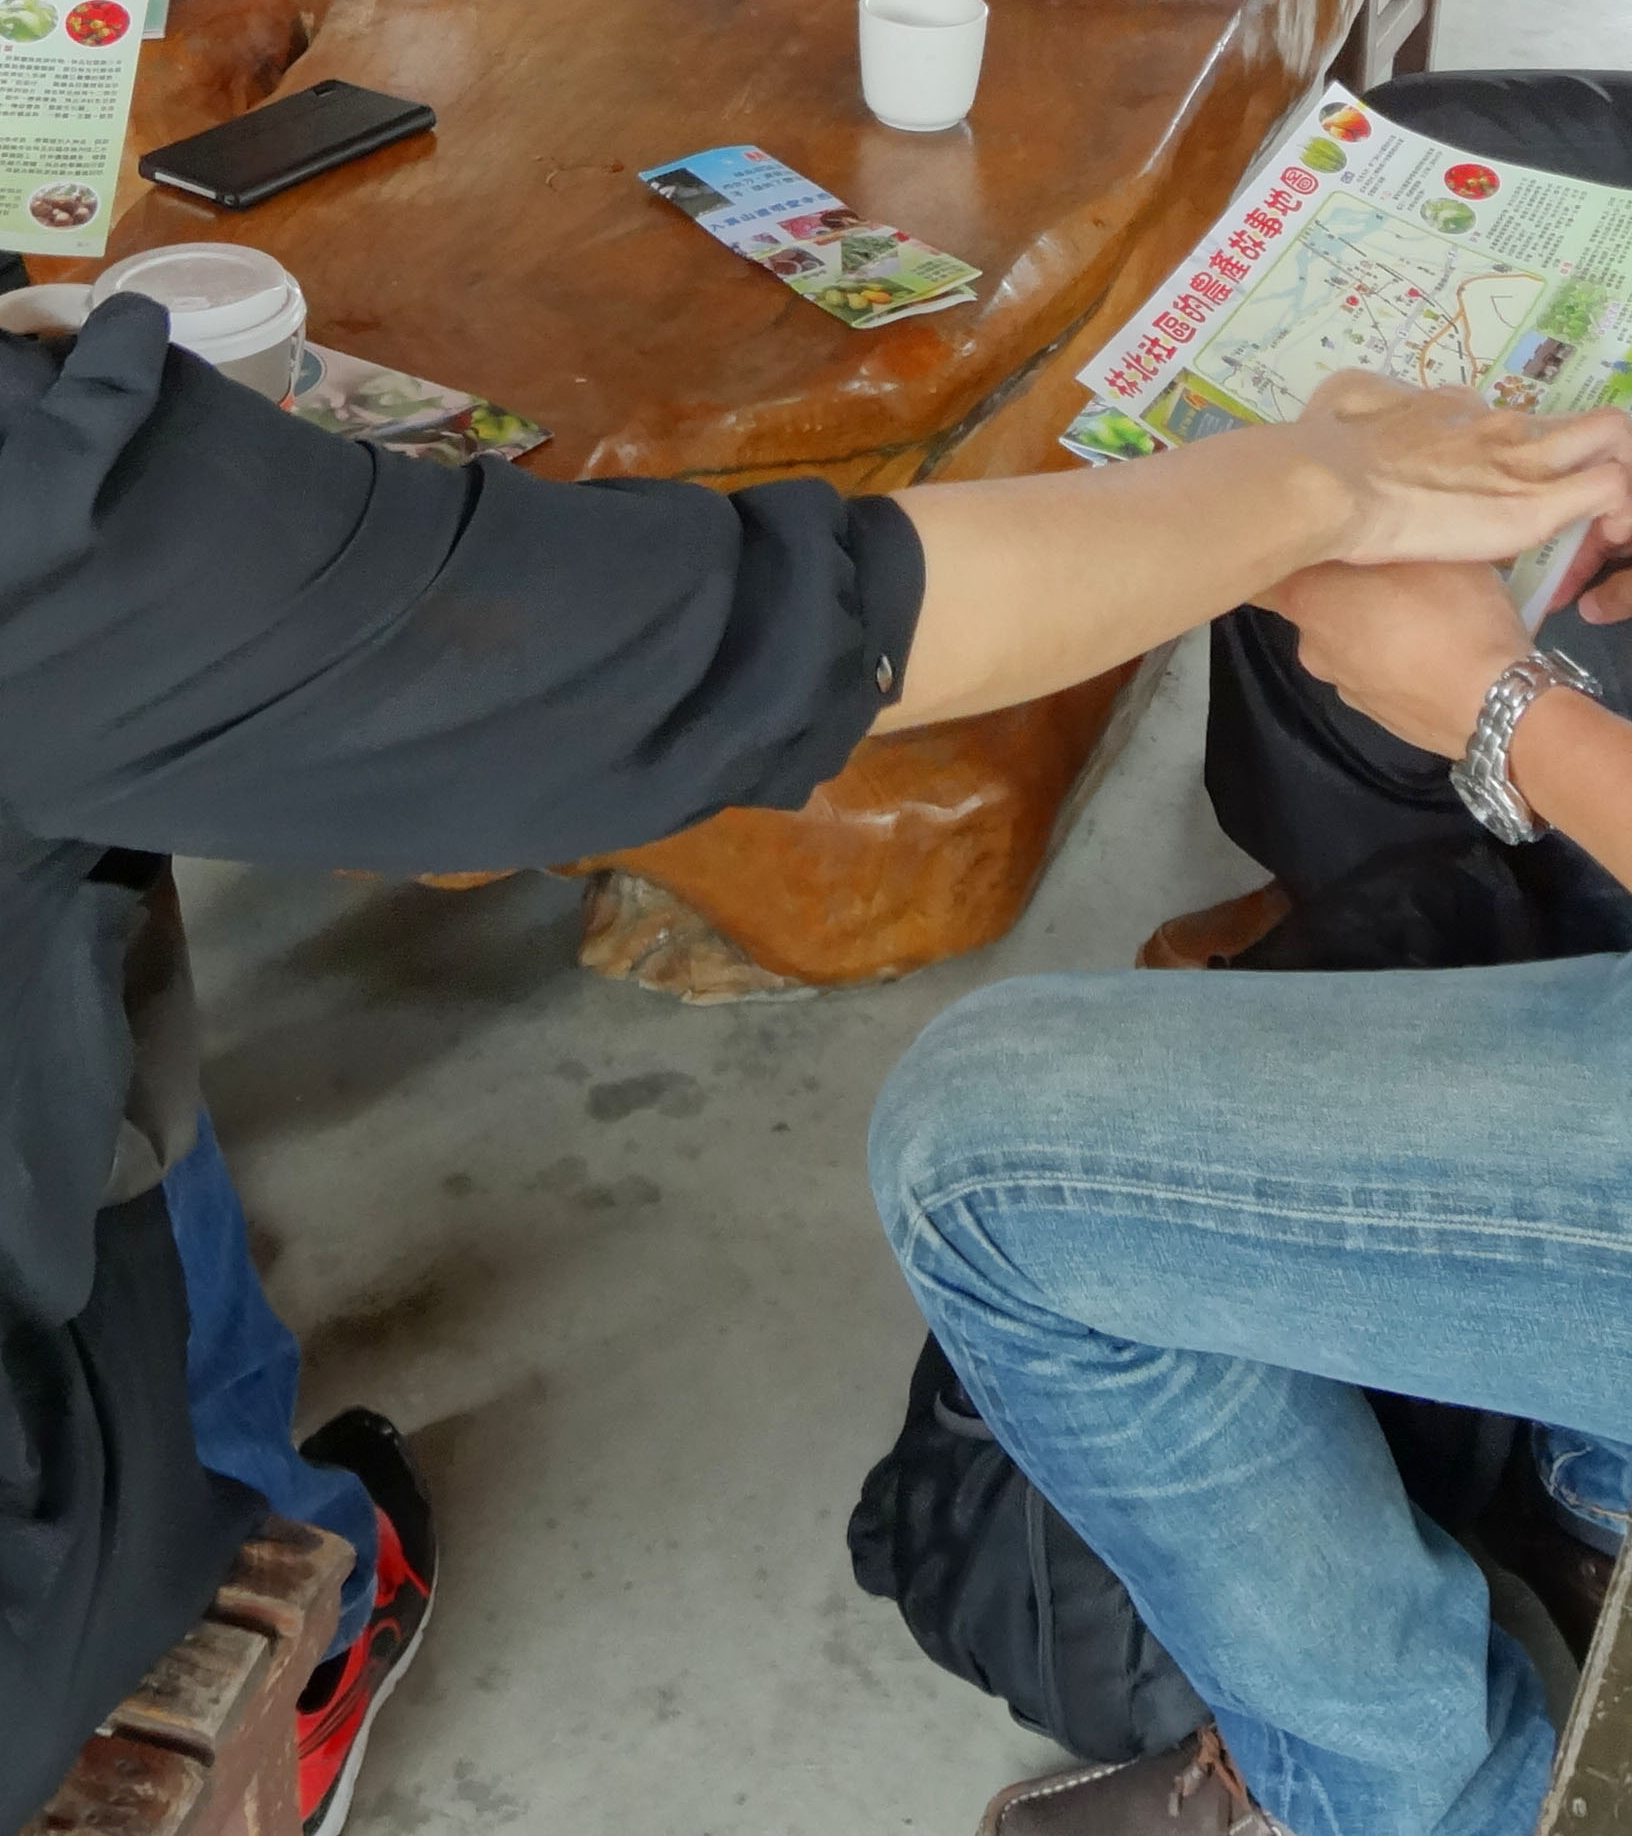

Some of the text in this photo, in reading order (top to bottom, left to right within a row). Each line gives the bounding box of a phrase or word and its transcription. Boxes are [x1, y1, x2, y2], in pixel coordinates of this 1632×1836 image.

[1103, 165, 1320, 400] 林北社區的農產故事地圖
